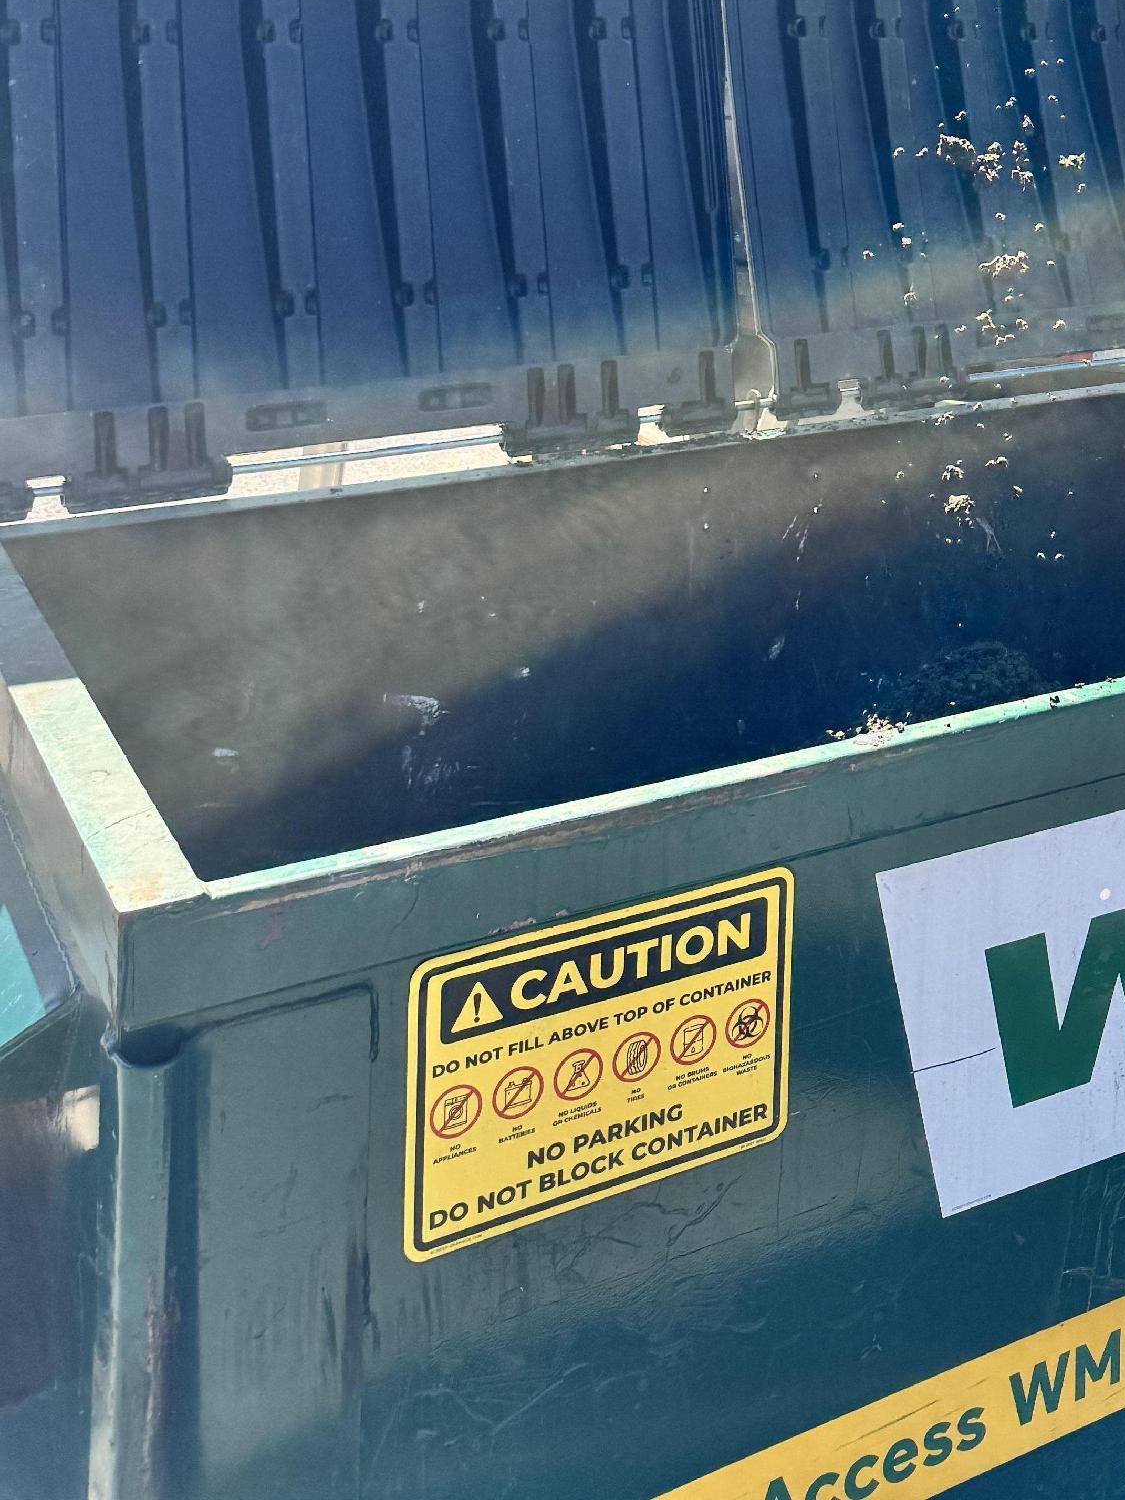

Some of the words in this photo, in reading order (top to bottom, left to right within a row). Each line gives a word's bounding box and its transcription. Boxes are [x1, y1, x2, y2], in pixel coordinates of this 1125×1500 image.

[510, 912, 751, 1010] CAUTION
[432, 1060, 460, 1078] DO
[465, 1047, 503, 1068] NOT
[508, 1036, 544, 1056] FILL
[548, 1016, 609, 1045] ABOVE
[614, 1006, 648, 1026] TOP
[652, 998, 675, 1014] OF
[679, 970, 772, 1006] CONTAINER
[676, 1073, 686, 1081] NO
[687, 1066, 710, 1077] DRUMS
[736, 1065, 758, 1076] WASTE
[667, 1083, 677, 1091] OR
[678, 1071, 717, 1088] CONTAINERS
[627, 1093, 645, 1103] TIRES
[552, 1119, 563, 1127] OR
[564, 1107, 602, 1123] CHEMICALS
[558, 1109, 569, 1117] NO
[570, 1101, 598, 1114] LIQUIDS
[498, 1127, 536, 1143] BATTERIES
[527, 1142, 565, 1168] NO
[573, 1103, 683, 1153] PARKING
[433, 1146, 477, 1165] APPLIANCES
[450, 1144, 461, 1152] NO
[429, 1202, 469, 1230] DO
[477, 1179, 533, 1213] NOT
[539, 1149, 625, 1193] BLOCK
[631, 1102, 768, 1162] CONTAINER
[1008, 1327, 1121, 1426] WM
